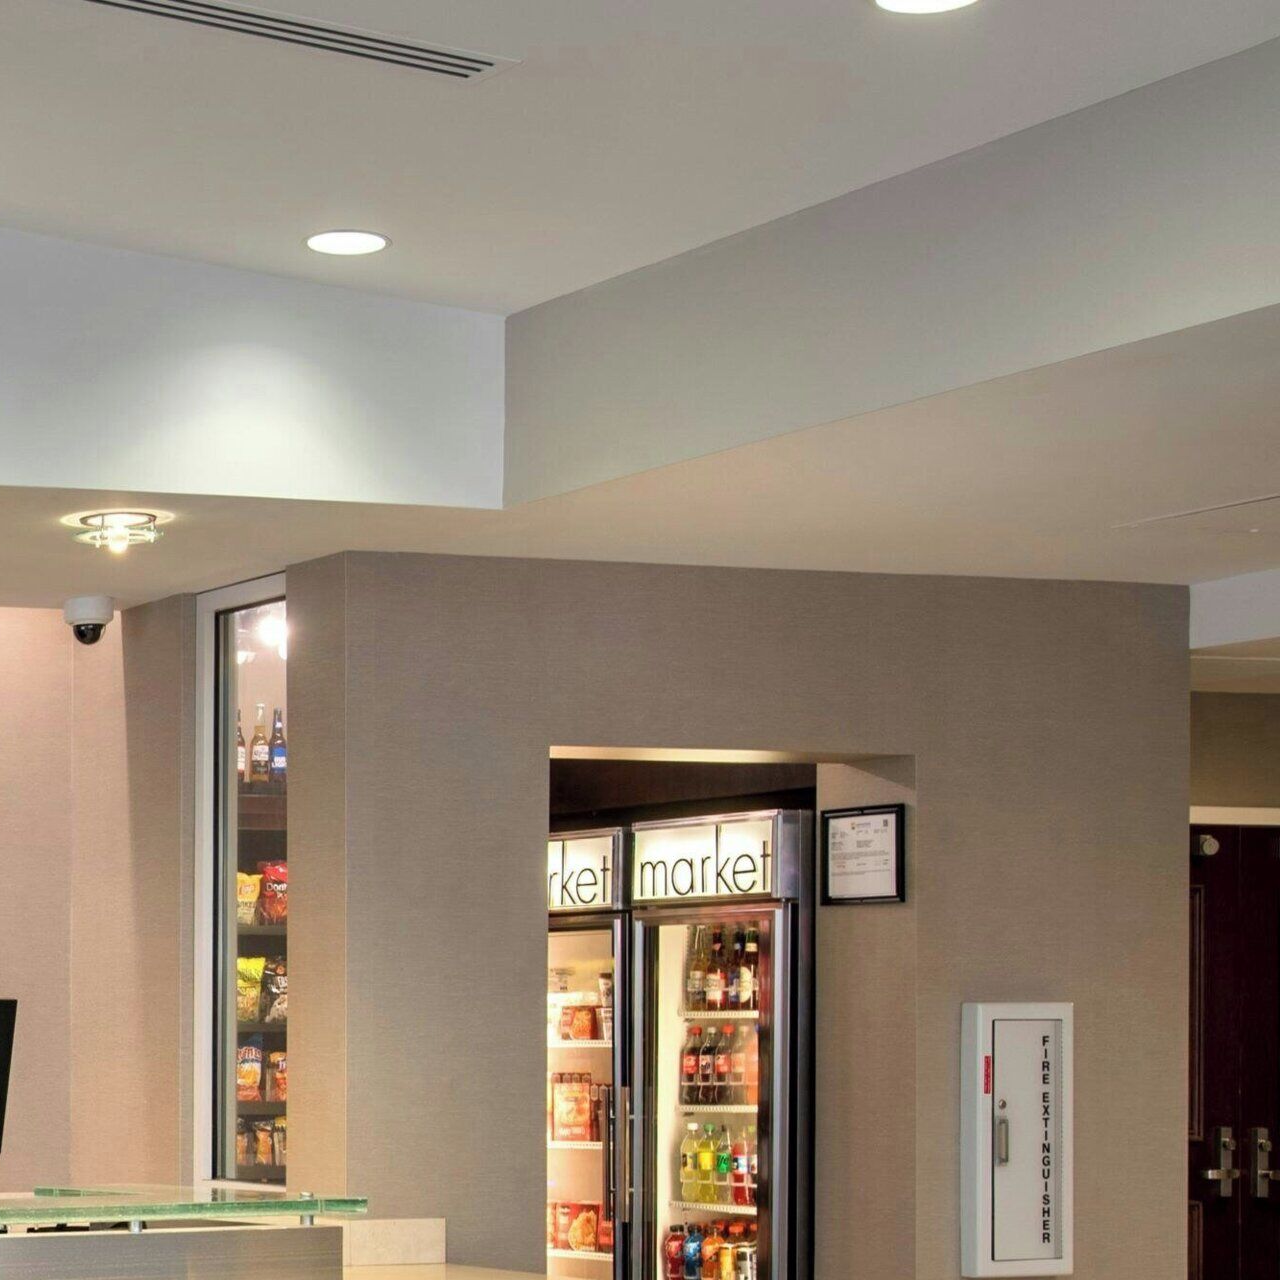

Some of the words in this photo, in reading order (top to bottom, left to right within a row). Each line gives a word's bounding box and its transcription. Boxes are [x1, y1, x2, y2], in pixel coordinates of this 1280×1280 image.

[549, 840, 611, 906] rket
[640, 824, 772, 897] market
[1042, 1035, 1050, 1085] FIRE
[1042, 1092, 1051, 1244] EXTINGUISHER
